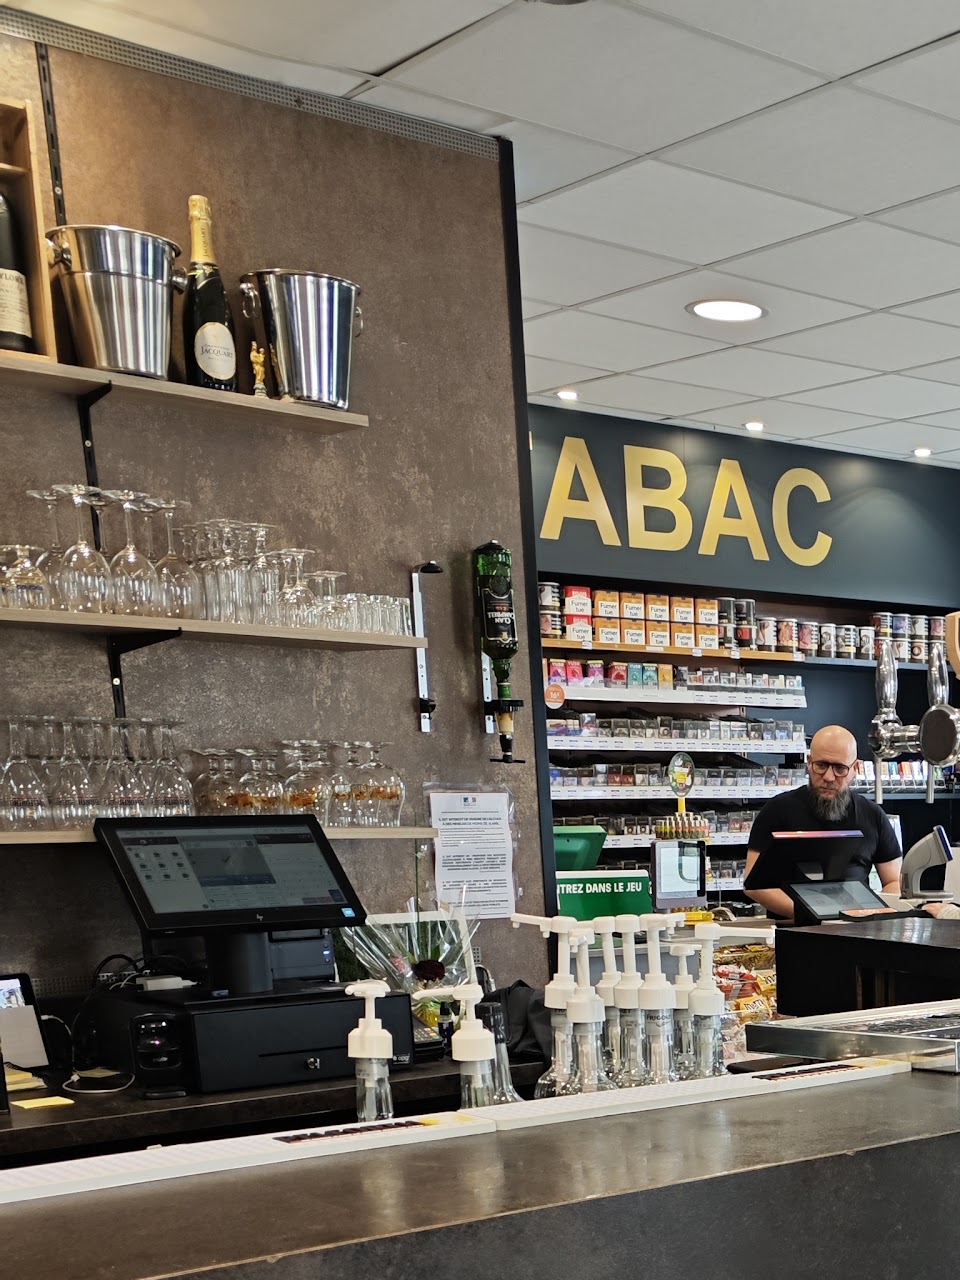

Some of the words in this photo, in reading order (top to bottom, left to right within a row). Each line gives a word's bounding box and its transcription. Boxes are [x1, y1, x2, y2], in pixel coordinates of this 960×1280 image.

[200, 346, 233, 358] JACQUART
[530, 436, 833, 567] ABAC
[556, 884, 584, 894] TREZ
[586, 883, 612, 894] DANS
[614, 882, 624, 892] LE
[626, 882, 642, 892] JEU
